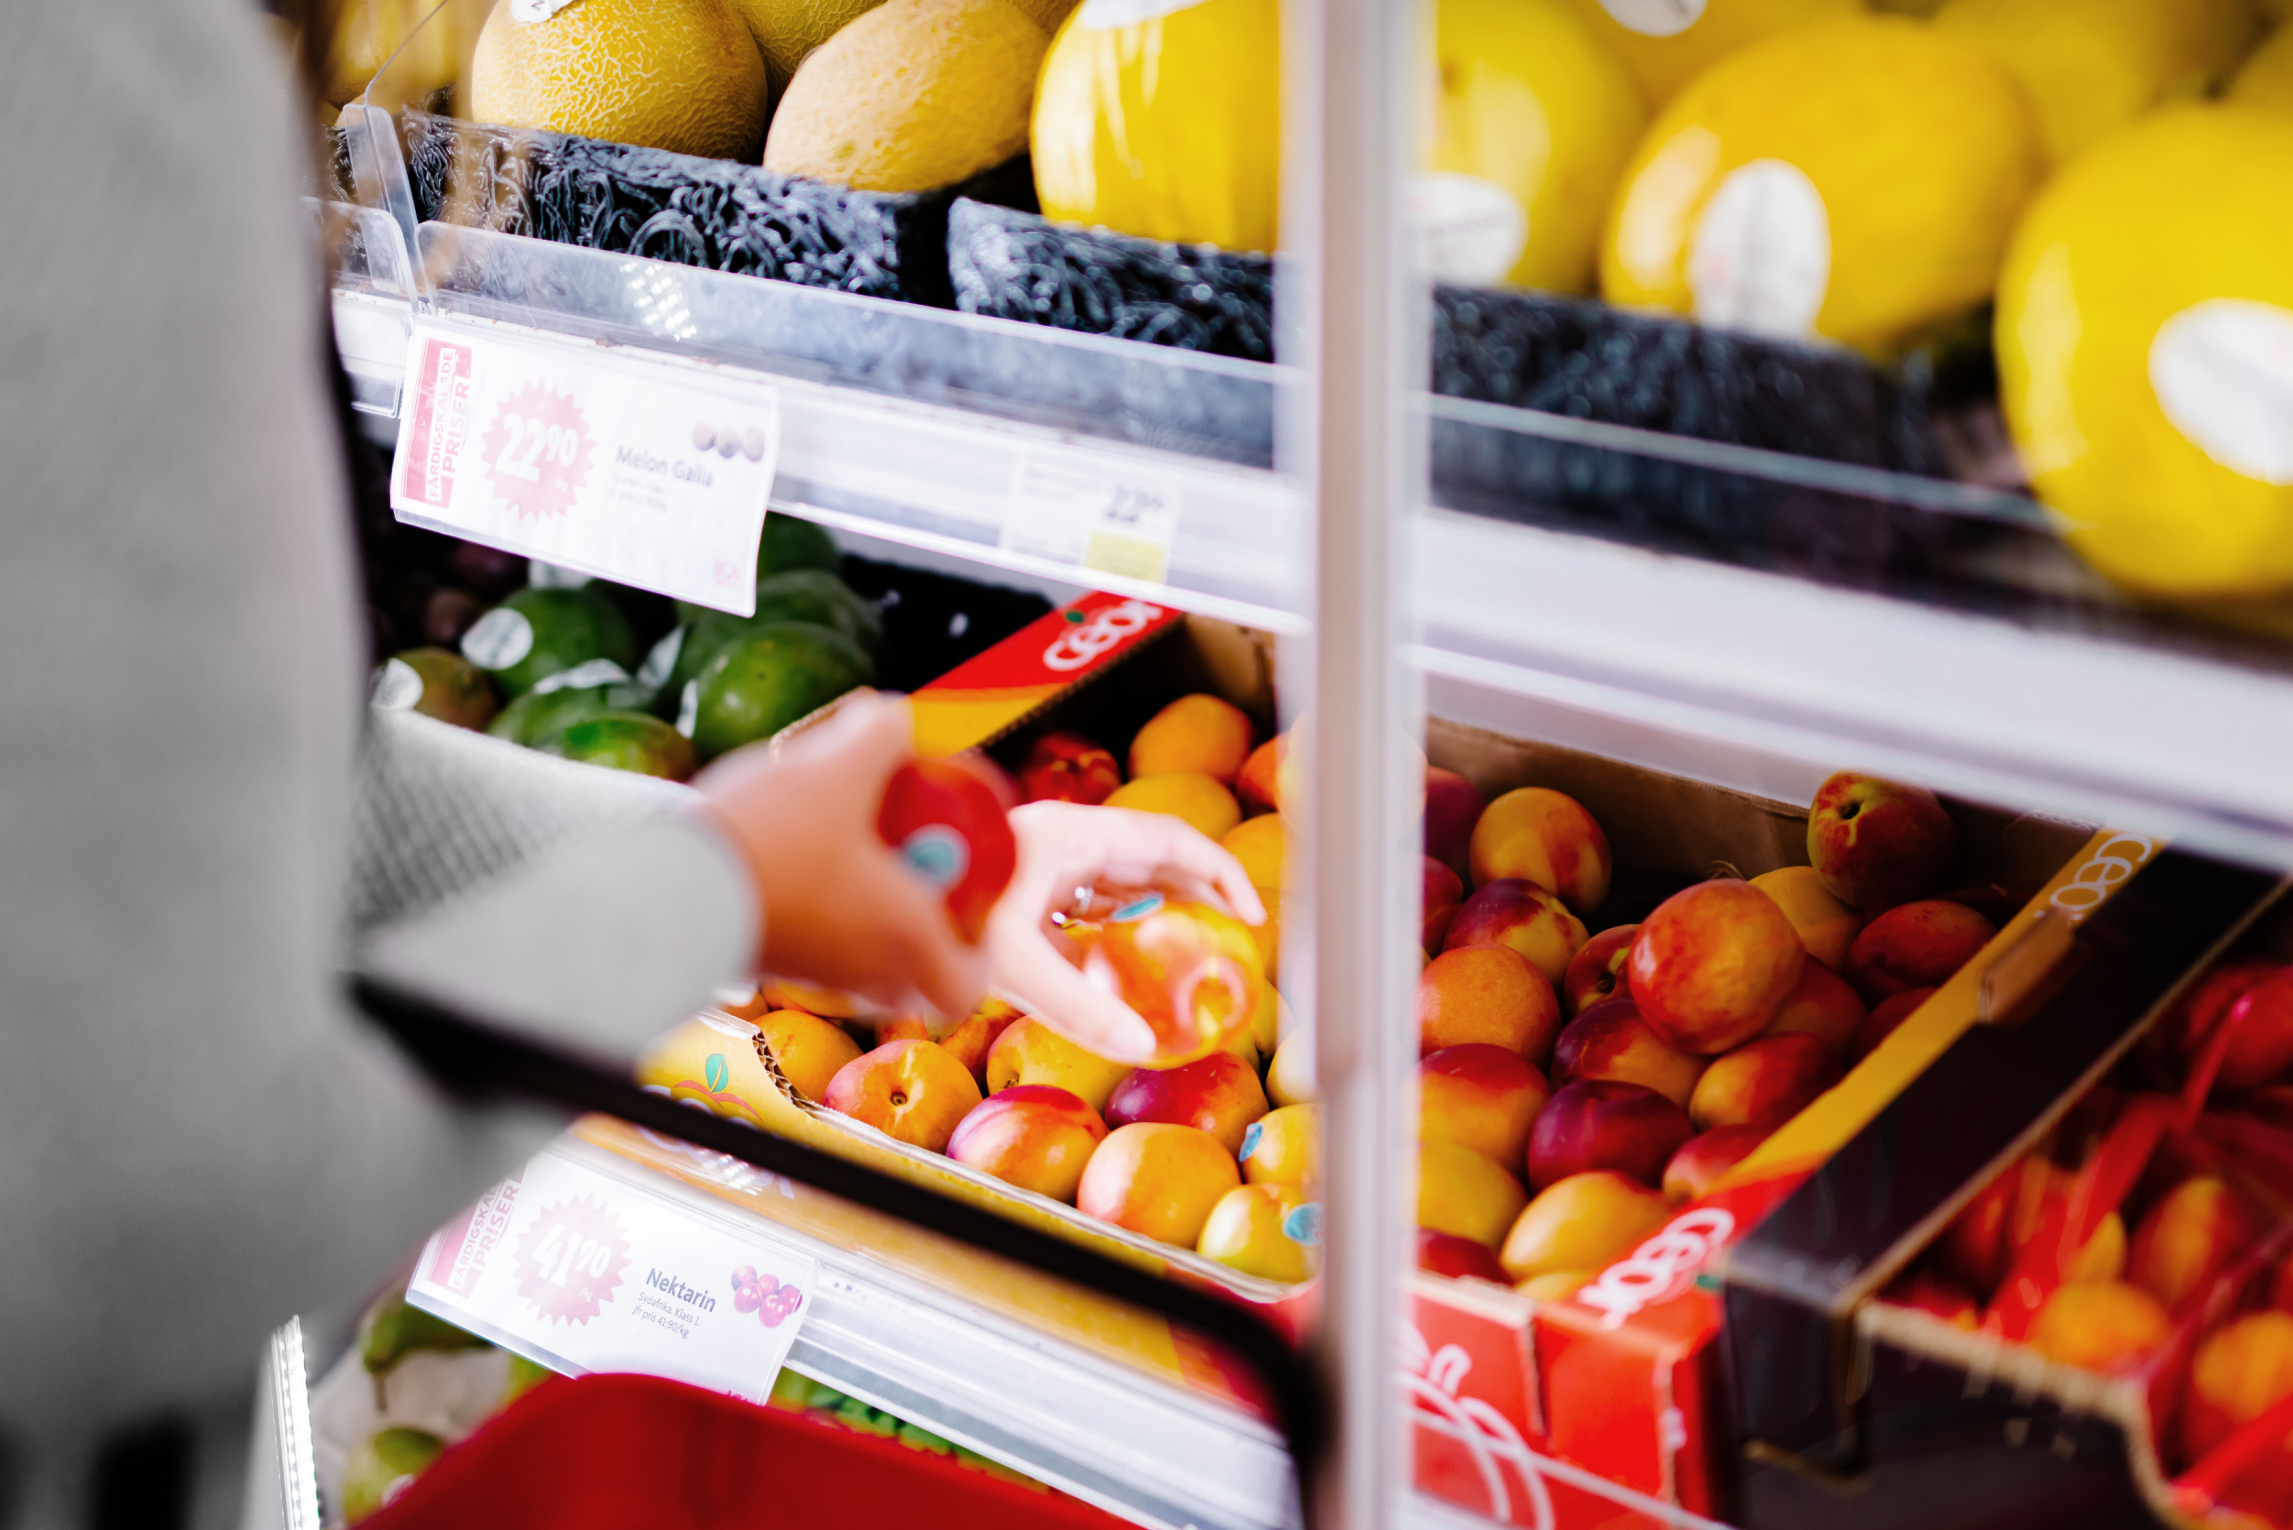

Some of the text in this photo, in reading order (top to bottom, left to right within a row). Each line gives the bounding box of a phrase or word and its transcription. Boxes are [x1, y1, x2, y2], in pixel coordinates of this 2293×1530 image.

[442, 381, 470, 474] PRISER
[616, 445, 668, 475] Melon
[452, 1186, 499, 1288] FÄRDIGSKAL
[472, 1184, 520, 1269] PRISER
[580, 1287, 594, 1303] /kg
[638, 1291, 700, 1327] Sydafrika. Klass 1.
[645, 1267, 717, 1313] Nektarin
[641, 1310, 657, 1323] pris
[657, 1315, 690, 1340] 41:90/kg
